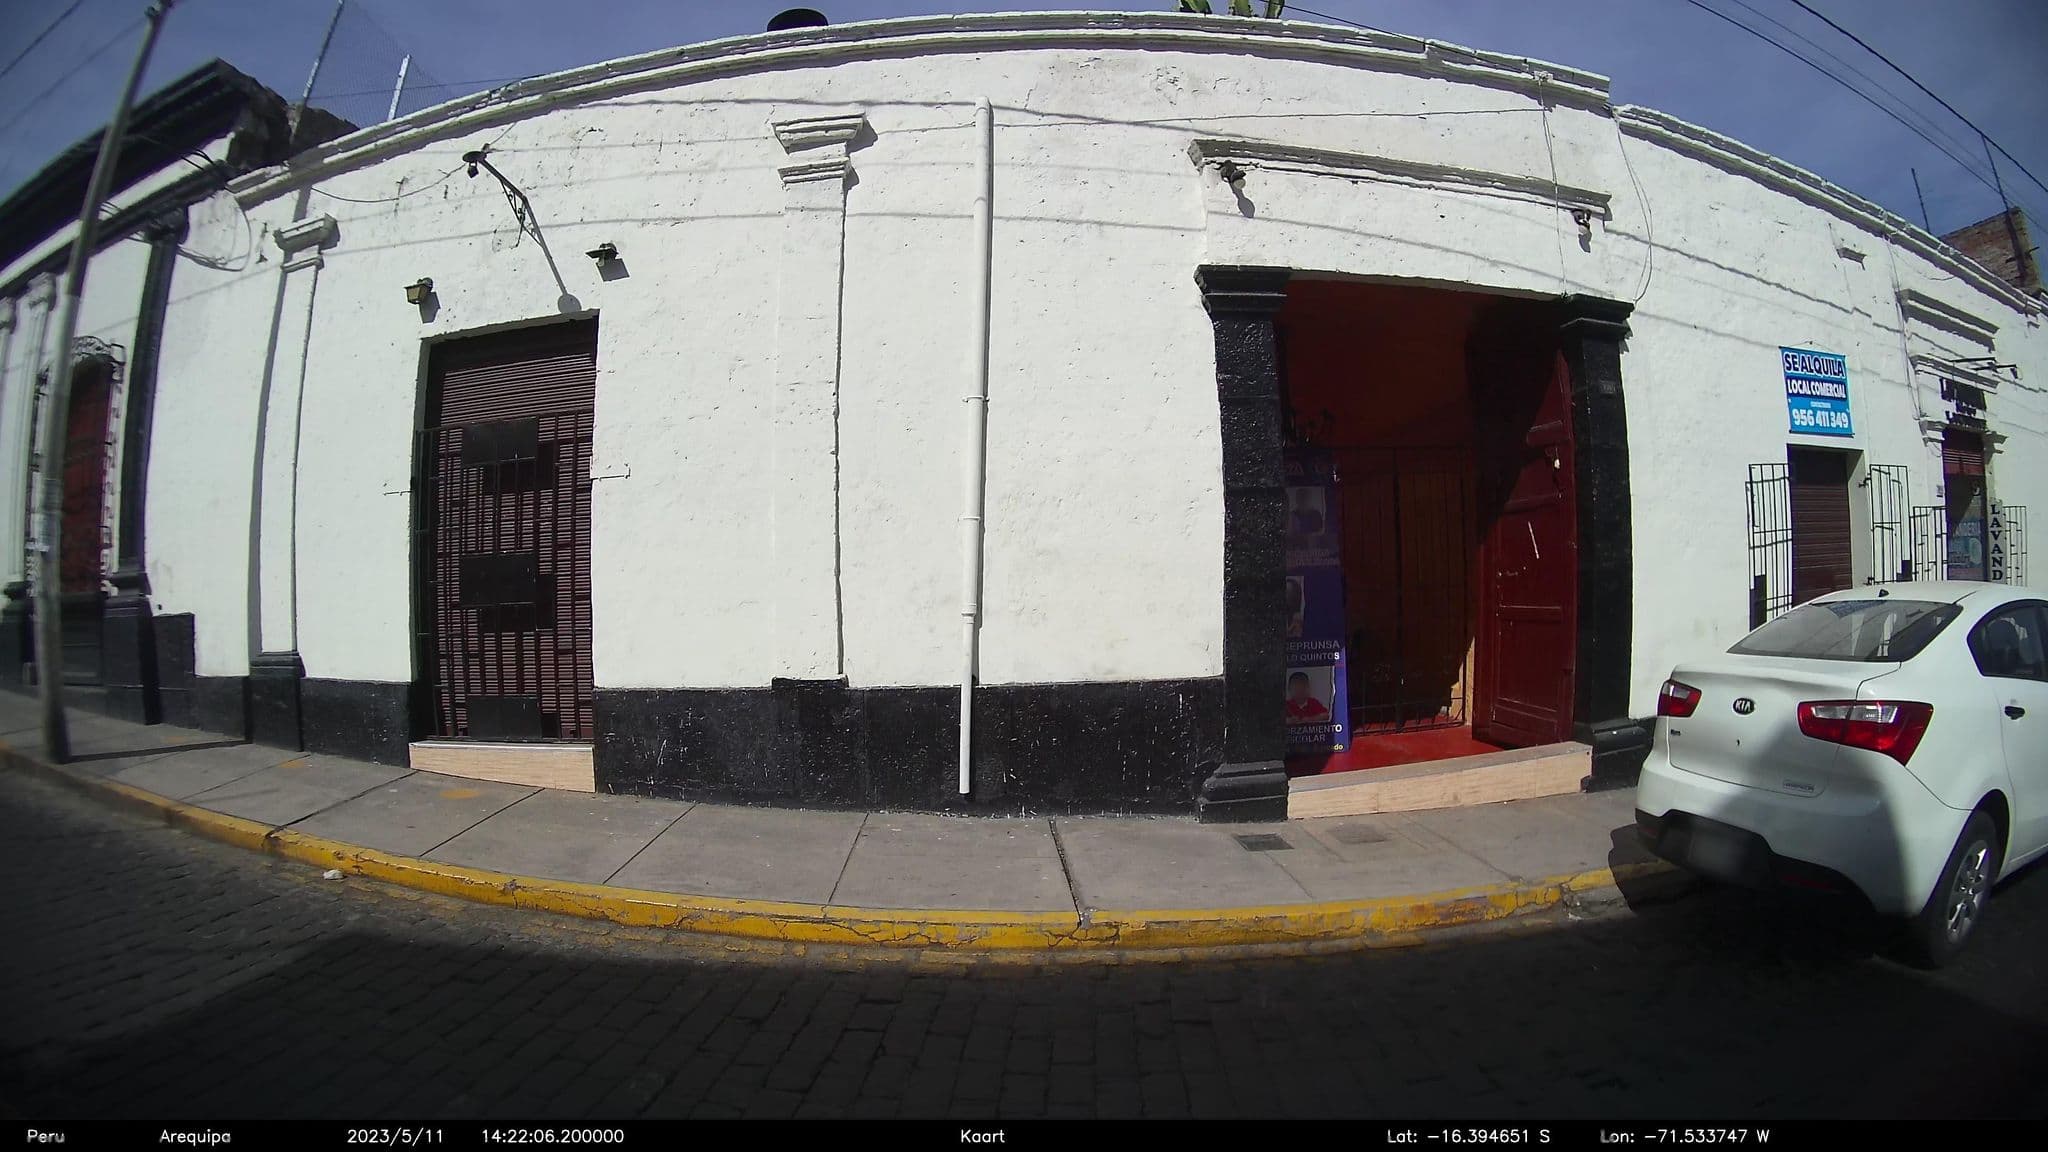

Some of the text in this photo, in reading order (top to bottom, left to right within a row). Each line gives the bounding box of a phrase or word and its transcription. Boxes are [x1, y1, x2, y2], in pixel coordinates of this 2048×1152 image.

[1783, 351, 1846, 378] SE ALQUILA
[1787, 379, 1846, 398] LOCAL COMERCIAL
[1792, 408, 1849, 429] 956 411 349
[1989, 503, 2004, 581] LAVAND
[1735, 699, 1752, 713] KIA
